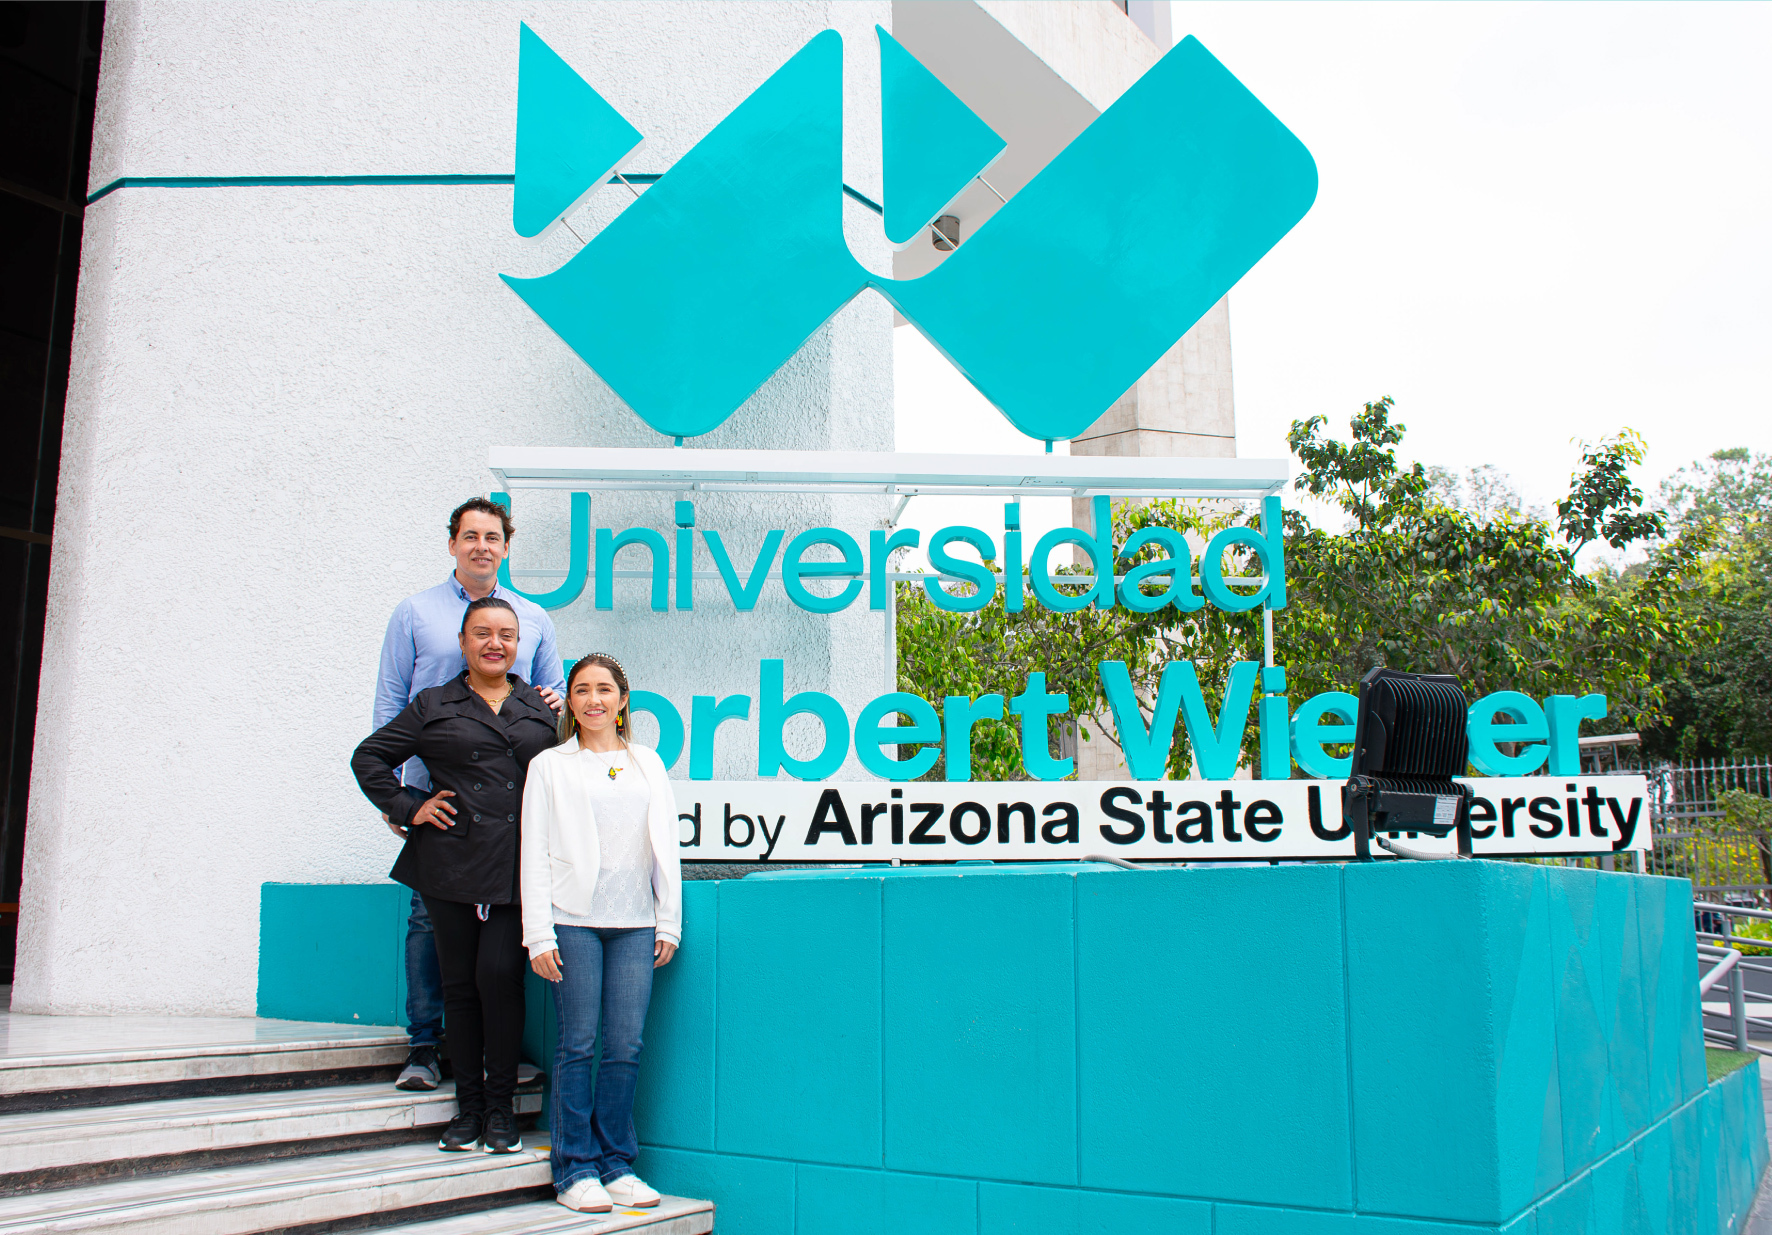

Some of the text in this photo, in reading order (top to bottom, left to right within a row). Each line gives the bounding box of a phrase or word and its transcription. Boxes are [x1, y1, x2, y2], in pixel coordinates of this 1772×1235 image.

[489, 491, 1287, 613] Universidad
[563, 658, 1607, 780] rbert Wieer
[724, 803, 786, 860] by
[804, 788, 1080, 845] Arizona
[1099, 786, 1284, 845] State
[1307, 783, 1643, 850] Uersity
